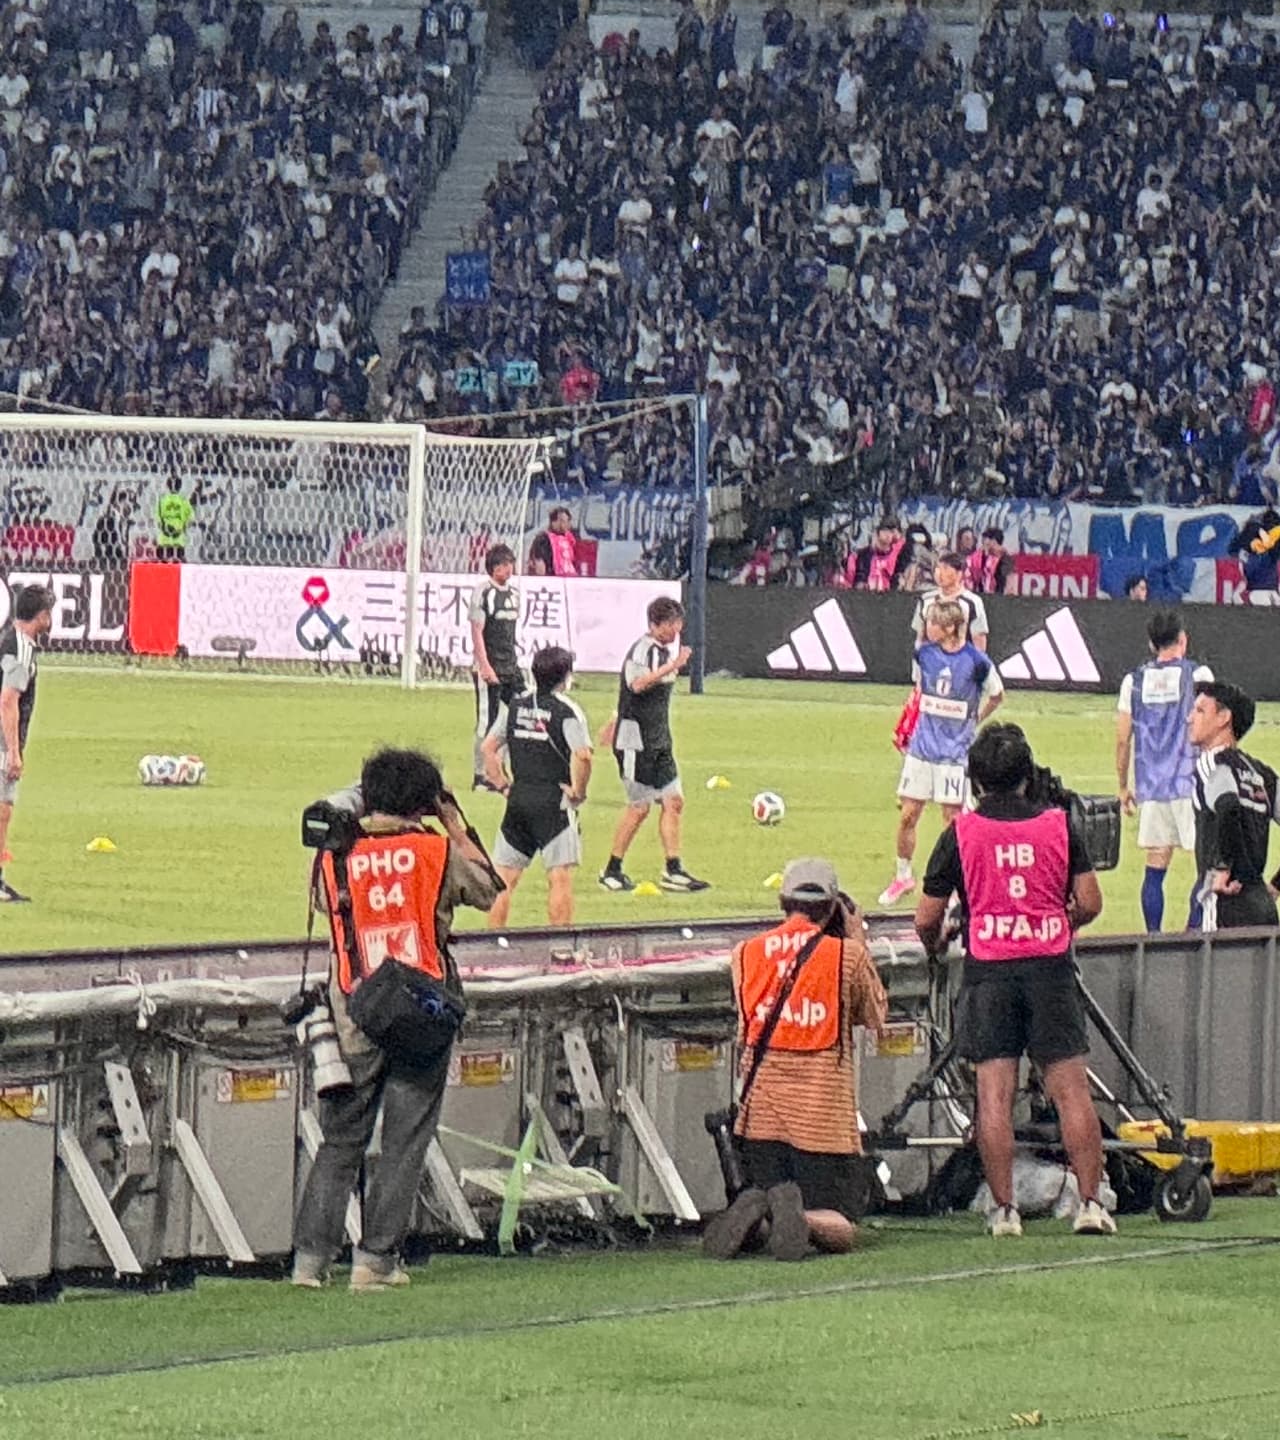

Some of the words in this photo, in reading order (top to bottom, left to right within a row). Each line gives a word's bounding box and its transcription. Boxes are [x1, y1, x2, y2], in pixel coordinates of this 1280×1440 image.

[362, 582, 561, 629] 三井不産
[363, 632, 439, 656] MITUI
[945, 778, 960, 797] 14
[350, 848, 416, 880] PHO
[995, 843, 1035, 868] HB
[368, 881, 405, 912] 64
[1009, 875, 1027, 899] 8
